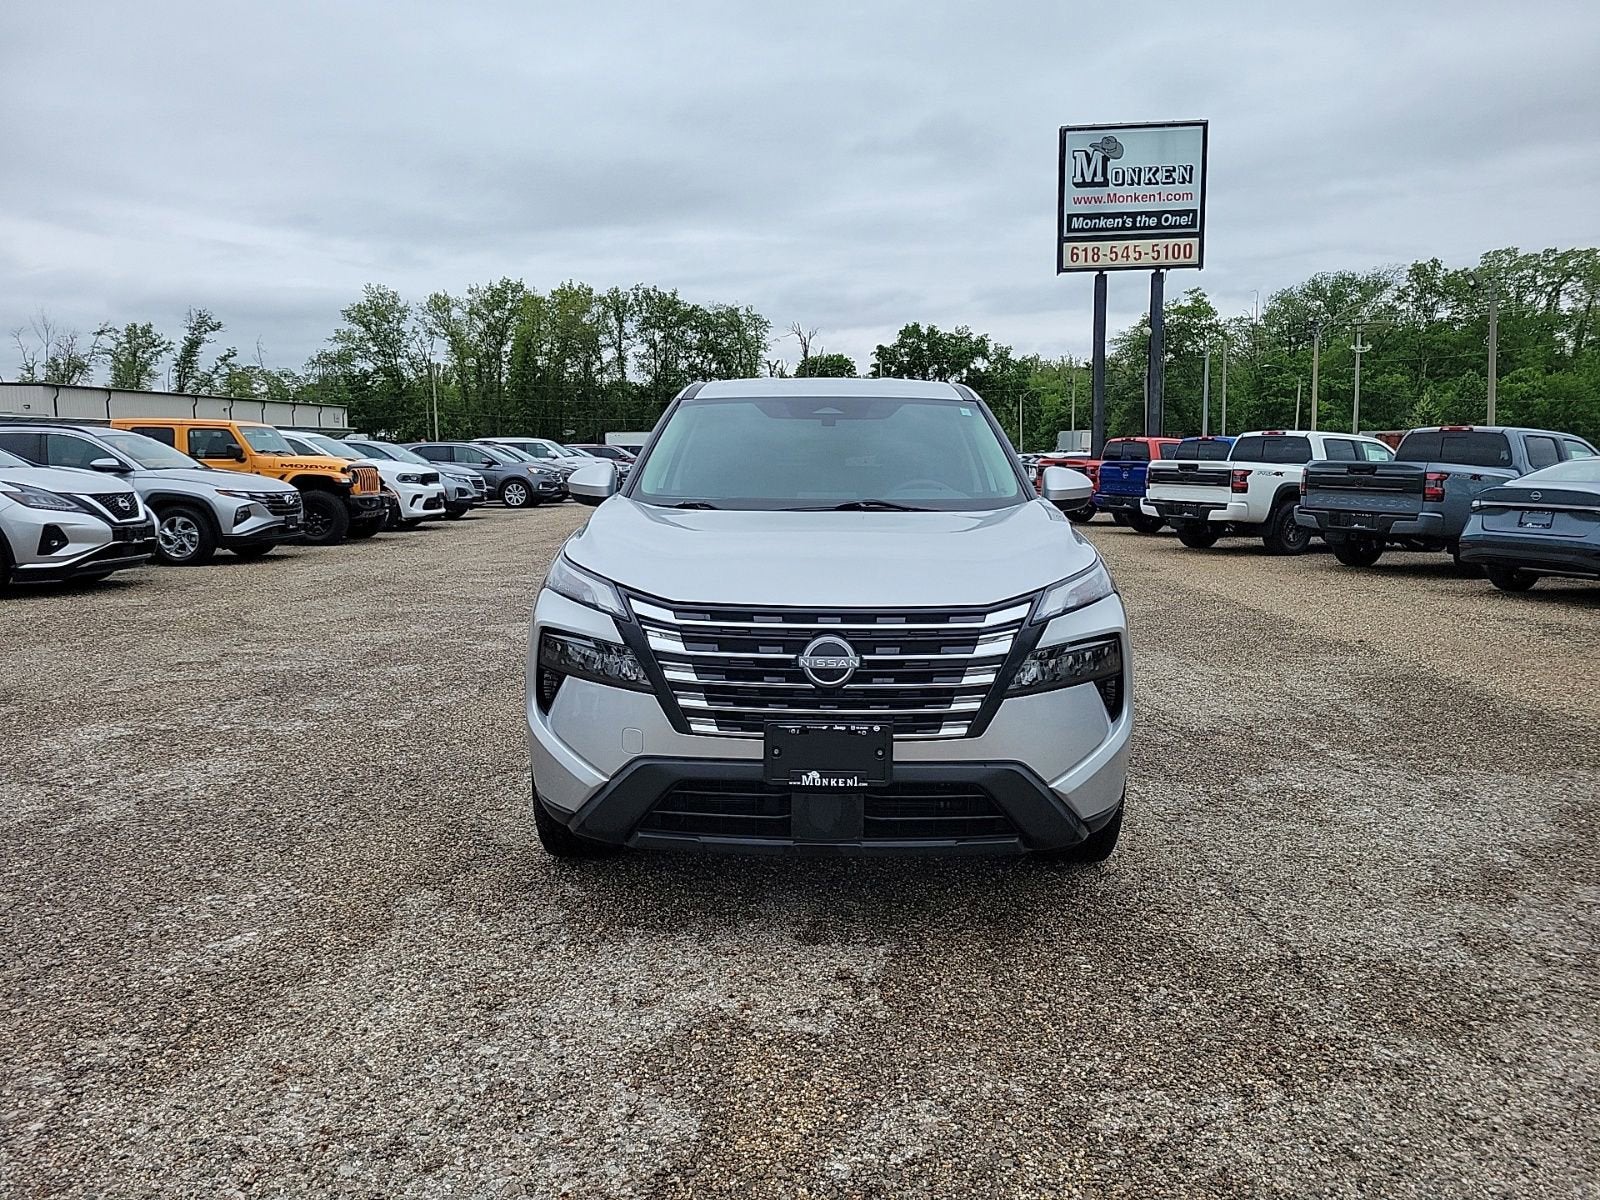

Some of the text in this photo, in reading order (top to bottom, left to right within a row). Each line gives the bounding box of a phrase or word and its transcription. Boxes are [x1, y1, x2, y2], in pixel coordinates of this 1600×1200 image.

[1073, 191, 1193, 205] www.Monken1.com
[1071, 213, 1193, 229] Monken's the One!
[1070, 243, 1193, 263] 618-545-5100
[800, 658, 860, 667] NISSAN
